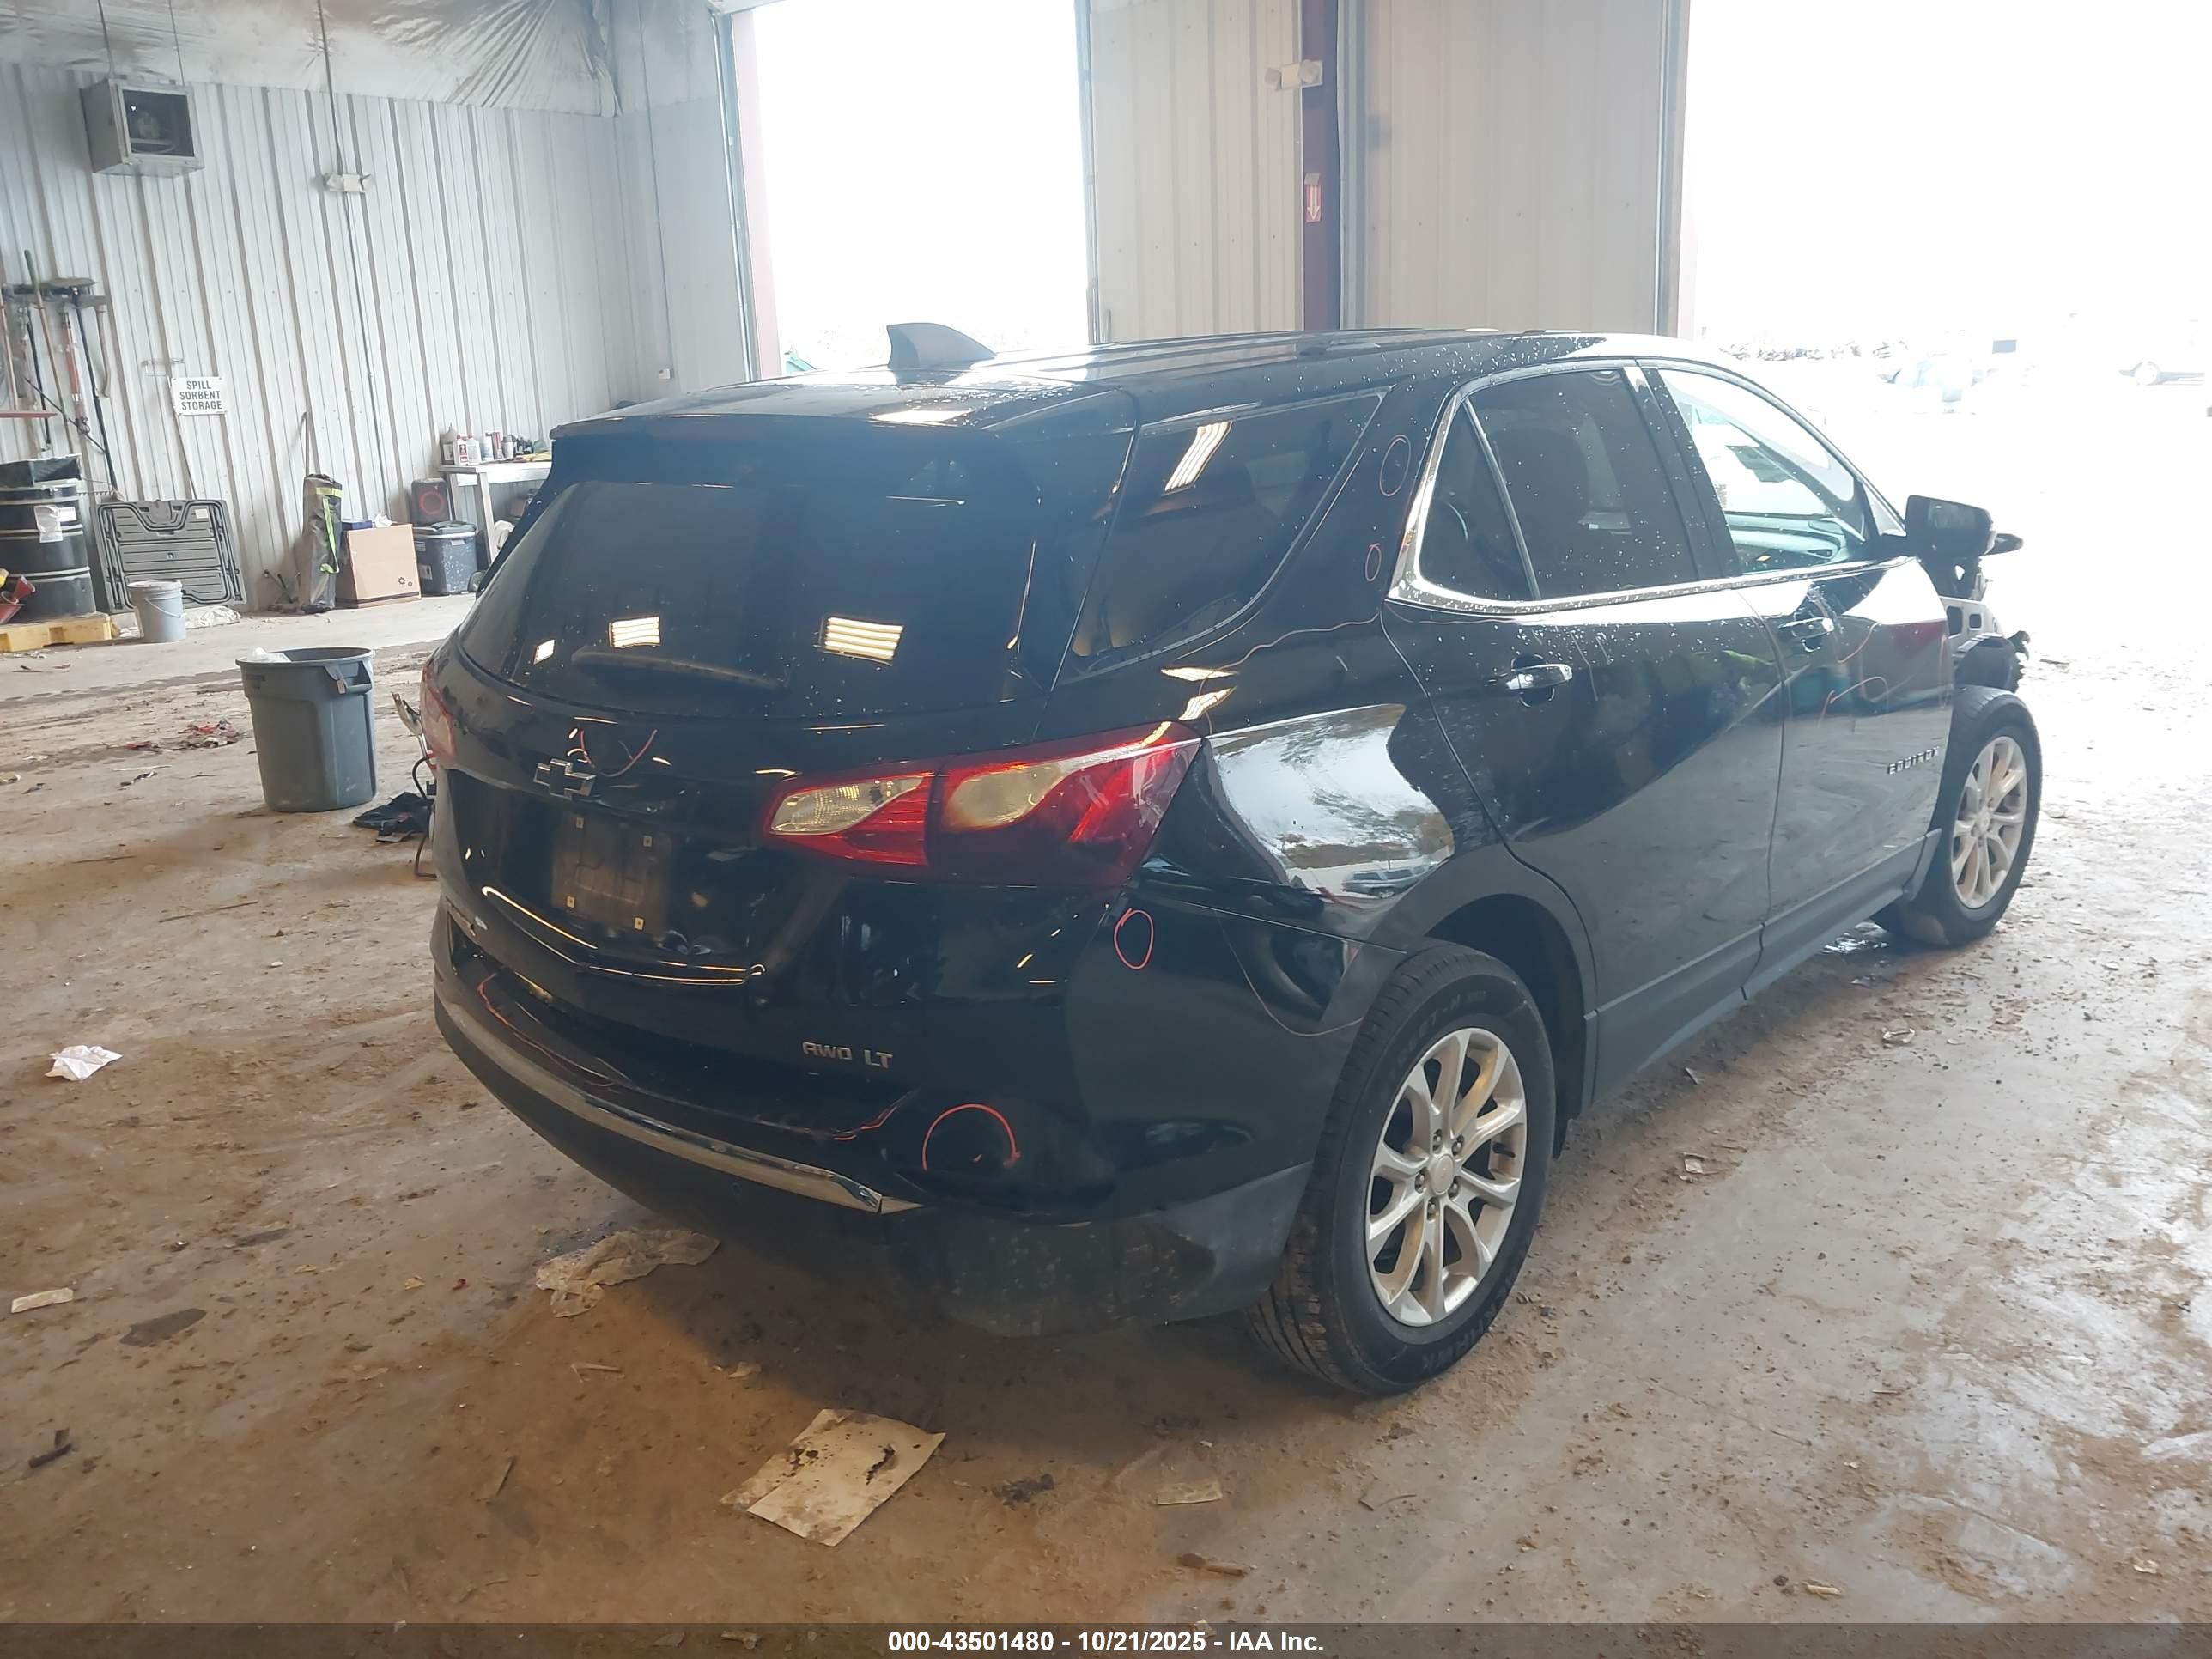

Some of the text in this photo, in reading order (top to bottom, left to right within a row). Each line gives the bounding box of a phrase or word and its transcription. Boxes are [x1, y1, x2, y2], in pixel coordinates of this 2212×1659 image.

[186, 380, 211, 390] SPILL
[179, 391, 221, 400] SORBENT
[181, 401, 222, 410] STORAGE
[802, 1042, 894, 1069] AWD LT
